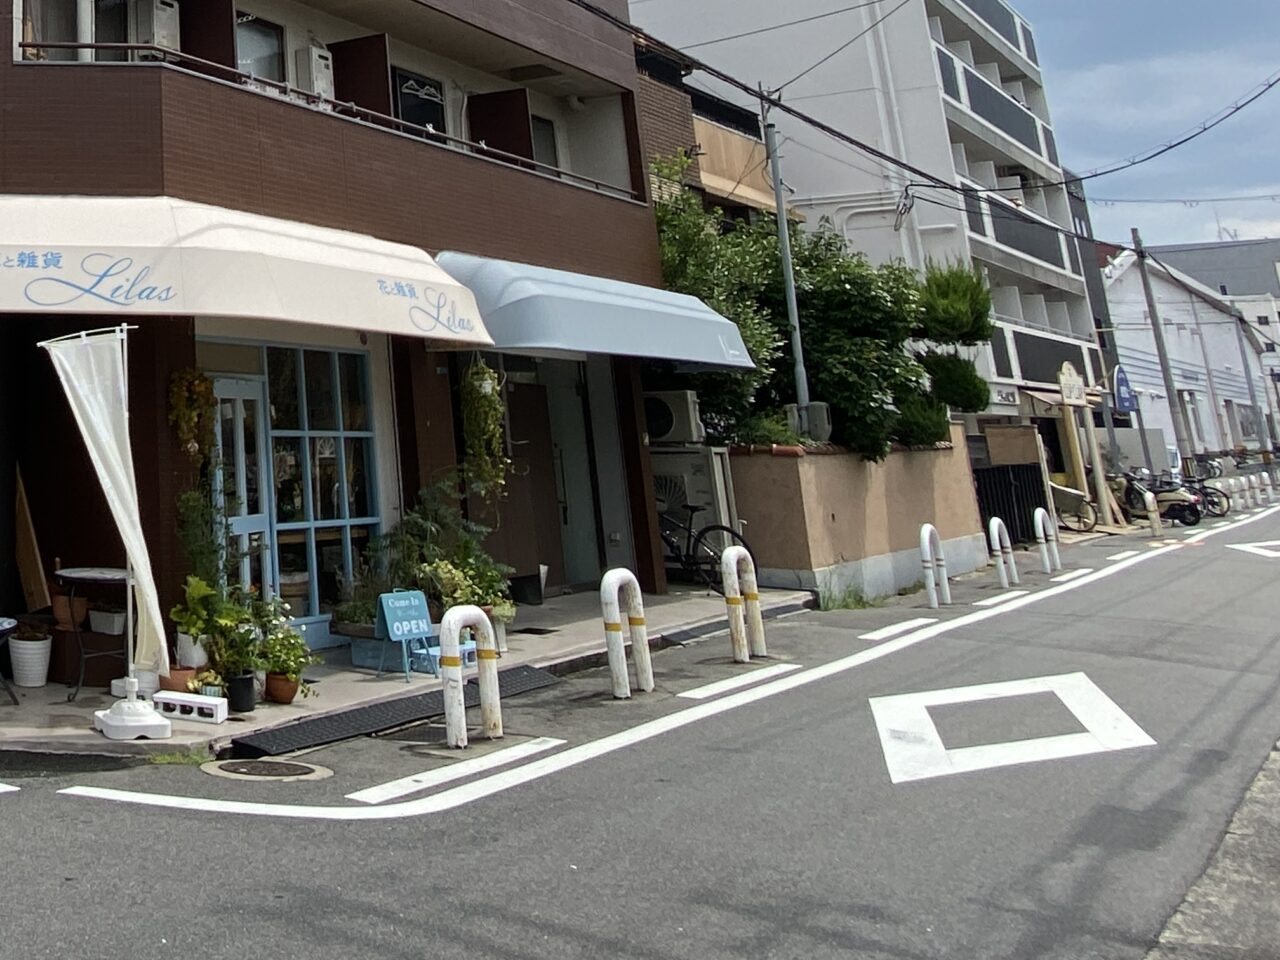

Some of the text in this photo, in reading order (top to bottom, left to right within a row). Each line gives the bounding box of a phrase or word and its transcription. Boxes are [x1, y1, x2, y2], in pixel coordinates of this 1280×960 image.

[24, 252, 178, 307] Lilas
[409, 286, 474, 335] Lilas
[393, 619, 428, 635] OPEN
